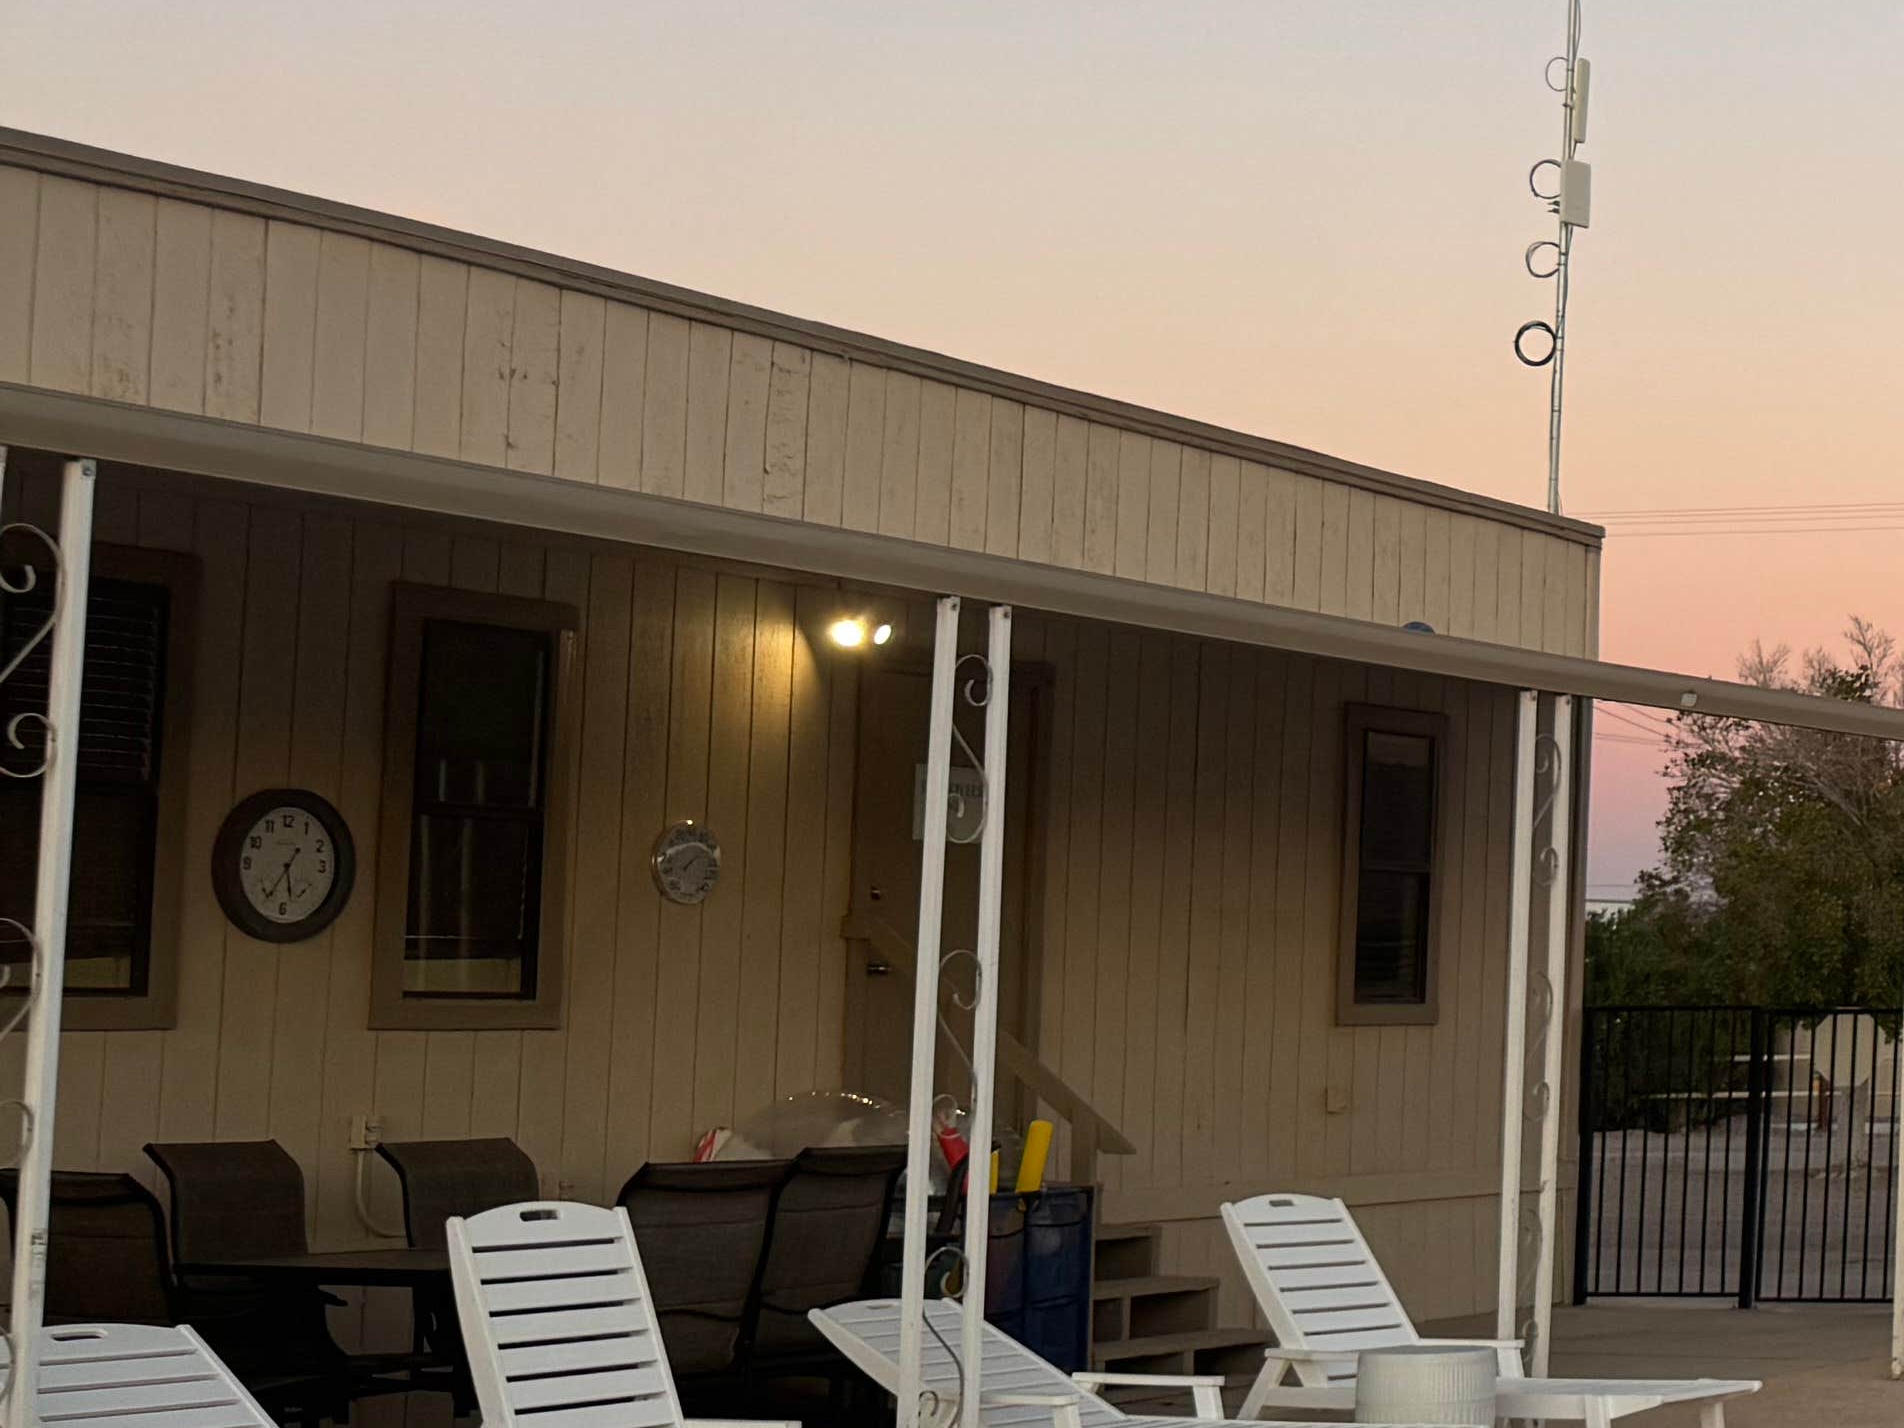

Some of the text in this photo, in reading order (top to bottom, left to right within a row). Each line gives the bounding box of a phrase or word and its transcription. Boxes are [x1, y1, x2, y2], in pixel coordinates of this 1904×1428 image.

[283, 814, 295, 828] 12
[315, 838, 325, 853] 2
[318, 859, 326, 874] 3
